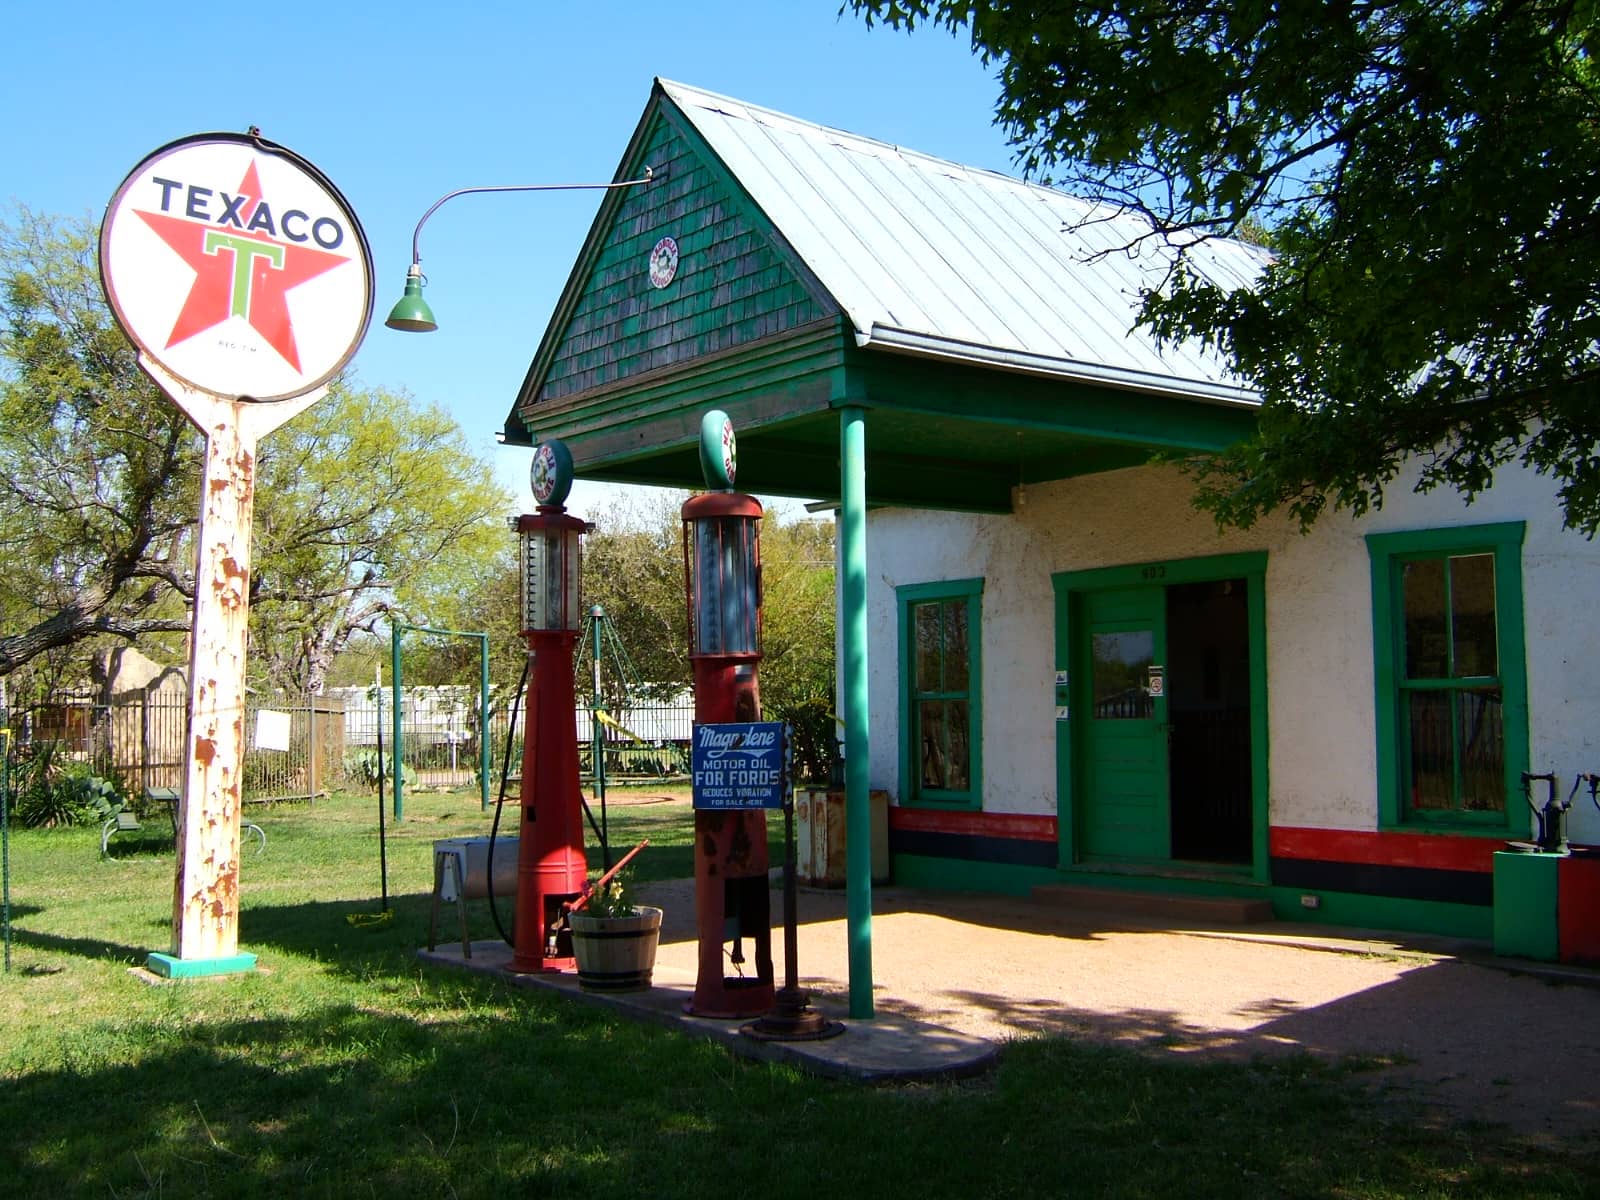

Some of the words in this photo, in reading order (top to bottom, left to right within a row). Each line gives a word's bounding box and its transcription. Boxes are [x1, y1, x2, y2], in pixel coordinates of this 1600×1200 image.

[152, 176, 344, 250] TEXACO
[204, 231, 284, 320] T
[703, 759, 746, 770] MOTOR
[751, 758, 771, 769] OIL
[695, 771, 724, 786] FOR
[729, 770, 780, 785] FORDS
[702, 788, 733, 797] REDUCES
